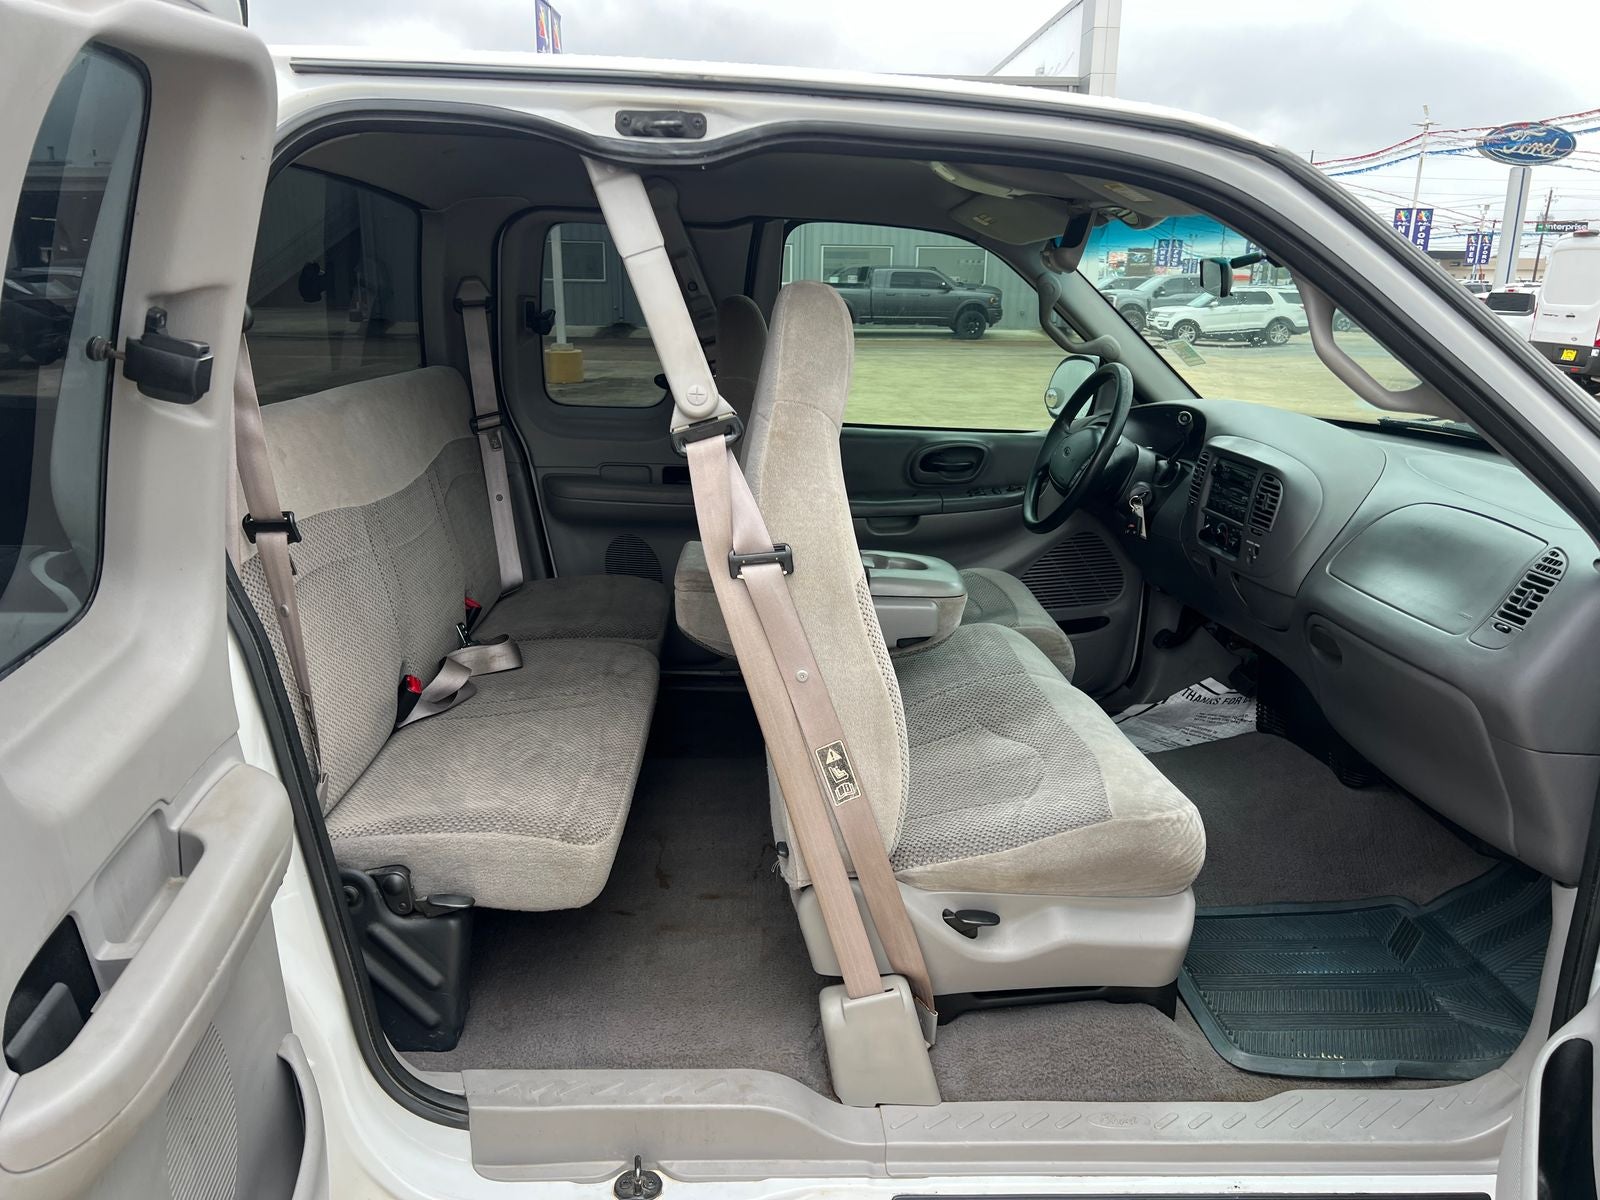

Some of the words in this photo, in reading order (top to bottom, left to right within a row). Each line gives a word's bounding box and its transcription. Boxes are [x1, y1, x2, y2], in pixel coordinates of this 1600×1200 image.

[1503, 130, 1560, 155] Ford
[1467, 246, 1475, 263] NEW
[1480, 246, 1489, 263] FORD
[1181, 687, 1220, 705] THANKS
[1221, 696, 1244, 705] FOR
